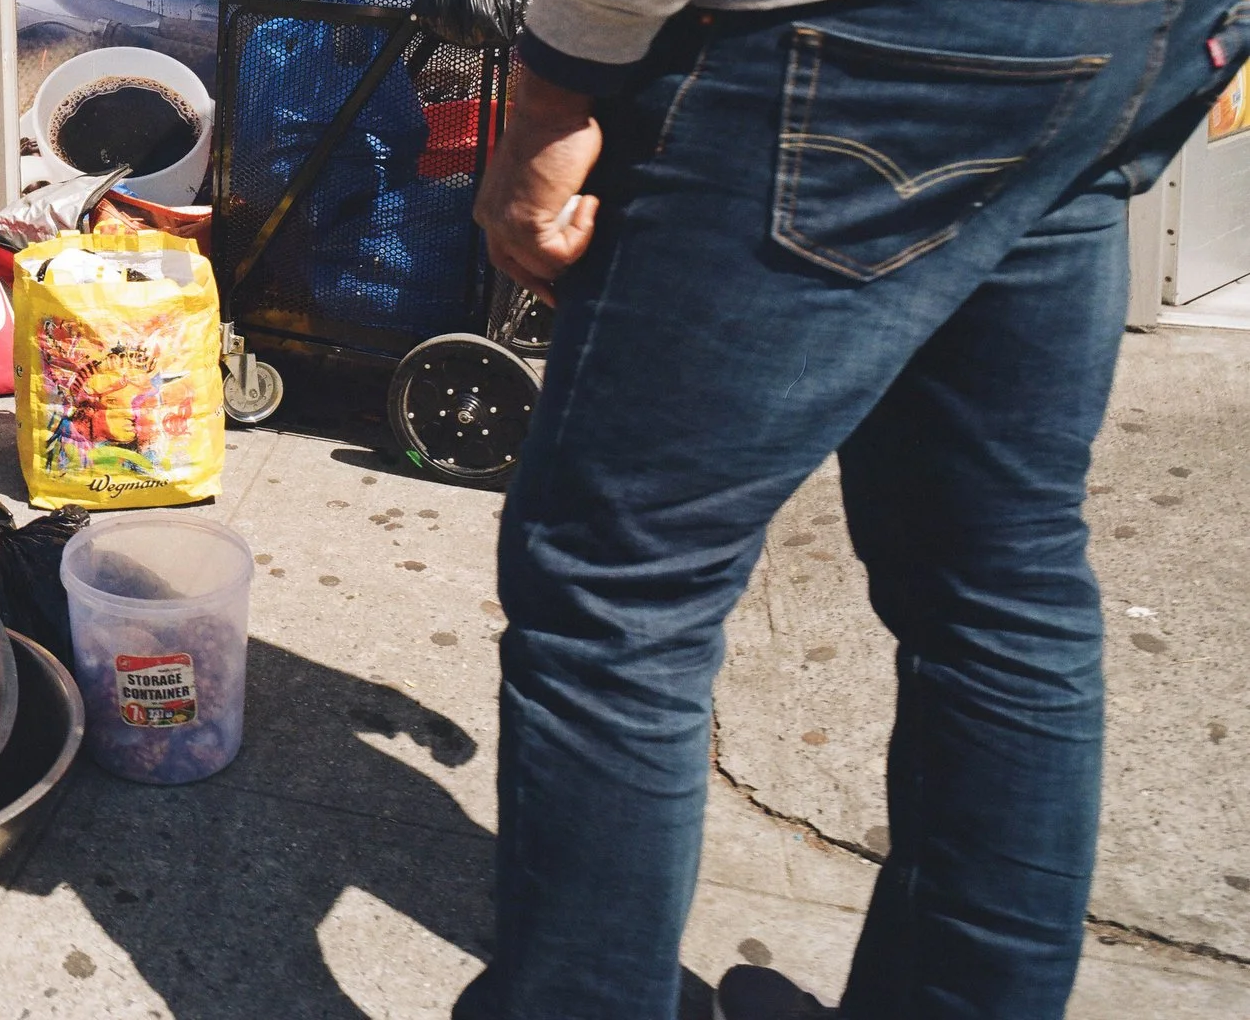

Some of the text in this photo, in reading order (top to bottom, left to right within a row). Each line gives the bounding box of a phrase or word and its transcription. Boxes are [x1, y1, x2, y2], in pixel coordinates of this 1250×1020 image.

[86, 474, 169, 498] Wegmans
[127, 673, 183, 687] STORAGE
[122, 685, 190, 700] CONTAINER
